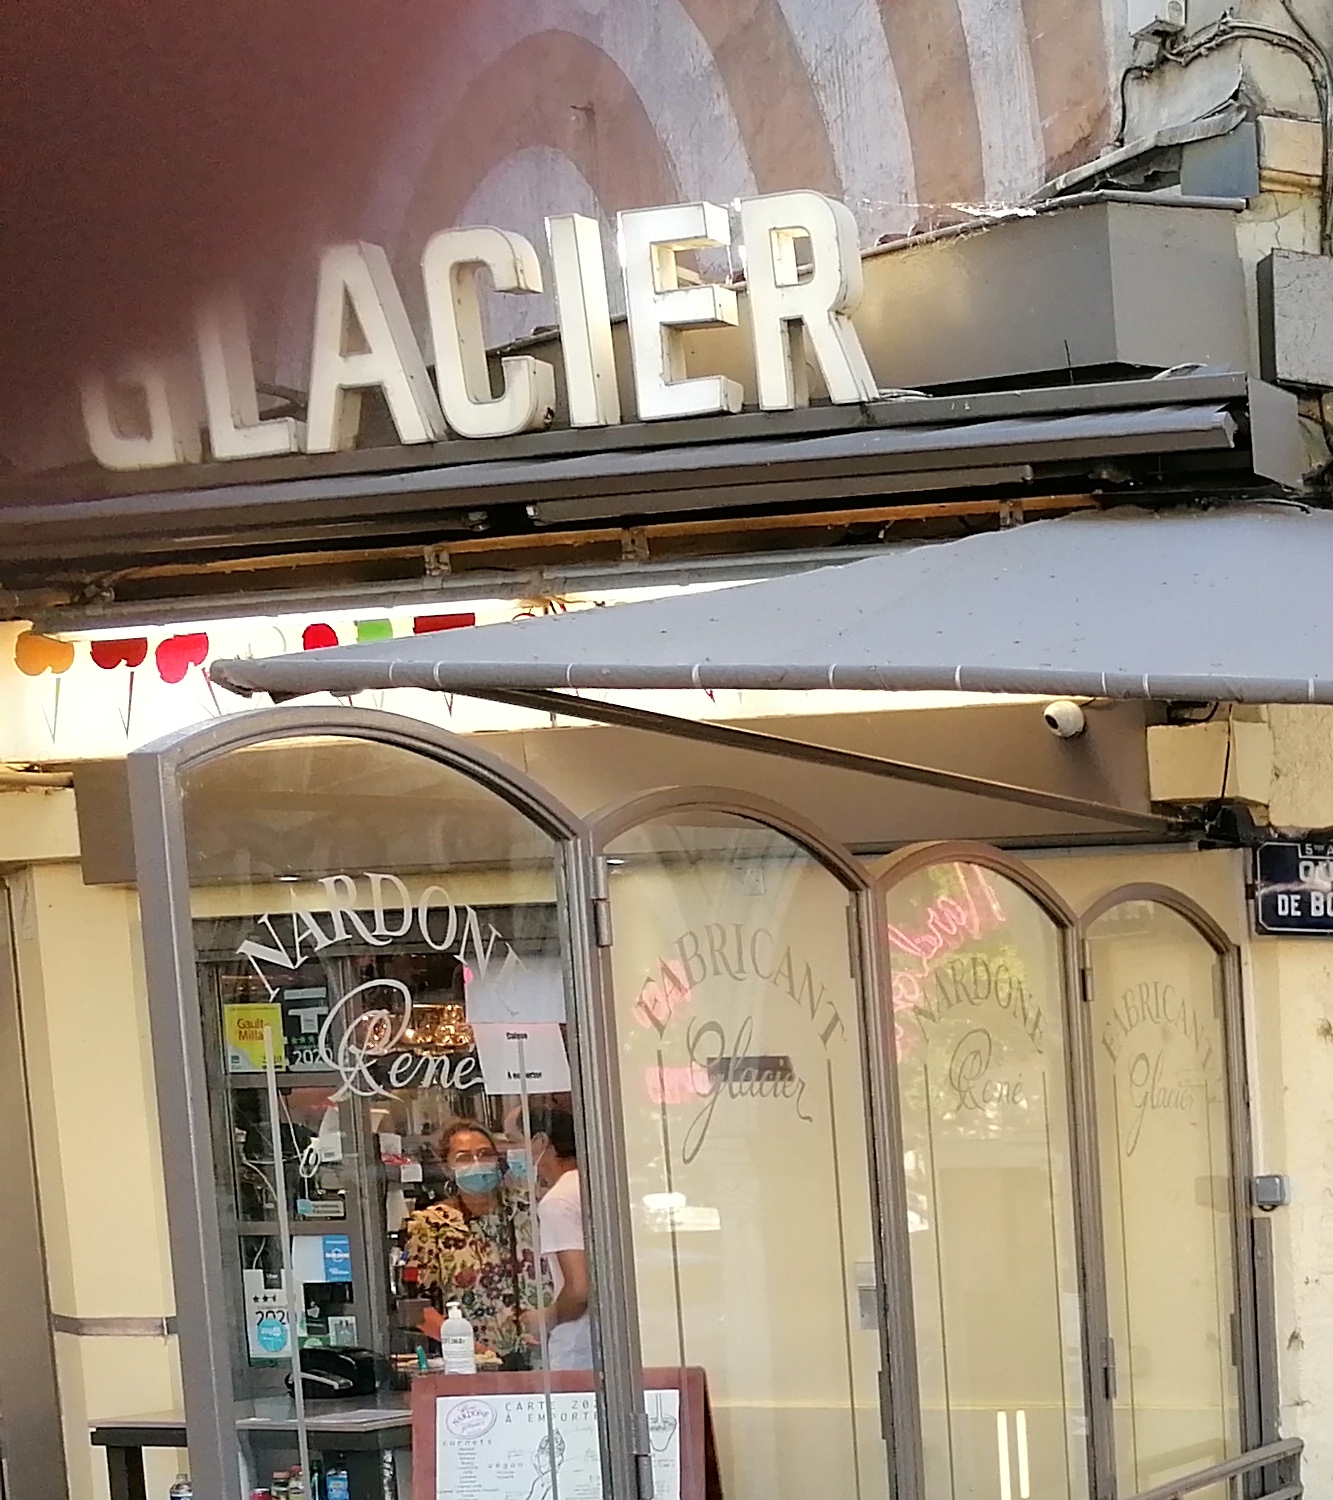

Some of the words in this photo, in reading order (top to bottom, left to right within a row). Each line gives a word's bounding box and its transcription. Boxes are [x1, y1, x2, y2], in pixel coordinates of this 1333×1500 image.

[1277, 894, 1301, 916] DE
[238, 1029, 270, 1041] Milla
[317, 978, 484, 1101] René
[635, 923, 848, 1051] FABRICANT
[682, 1015, 813, 1165] Glacier
